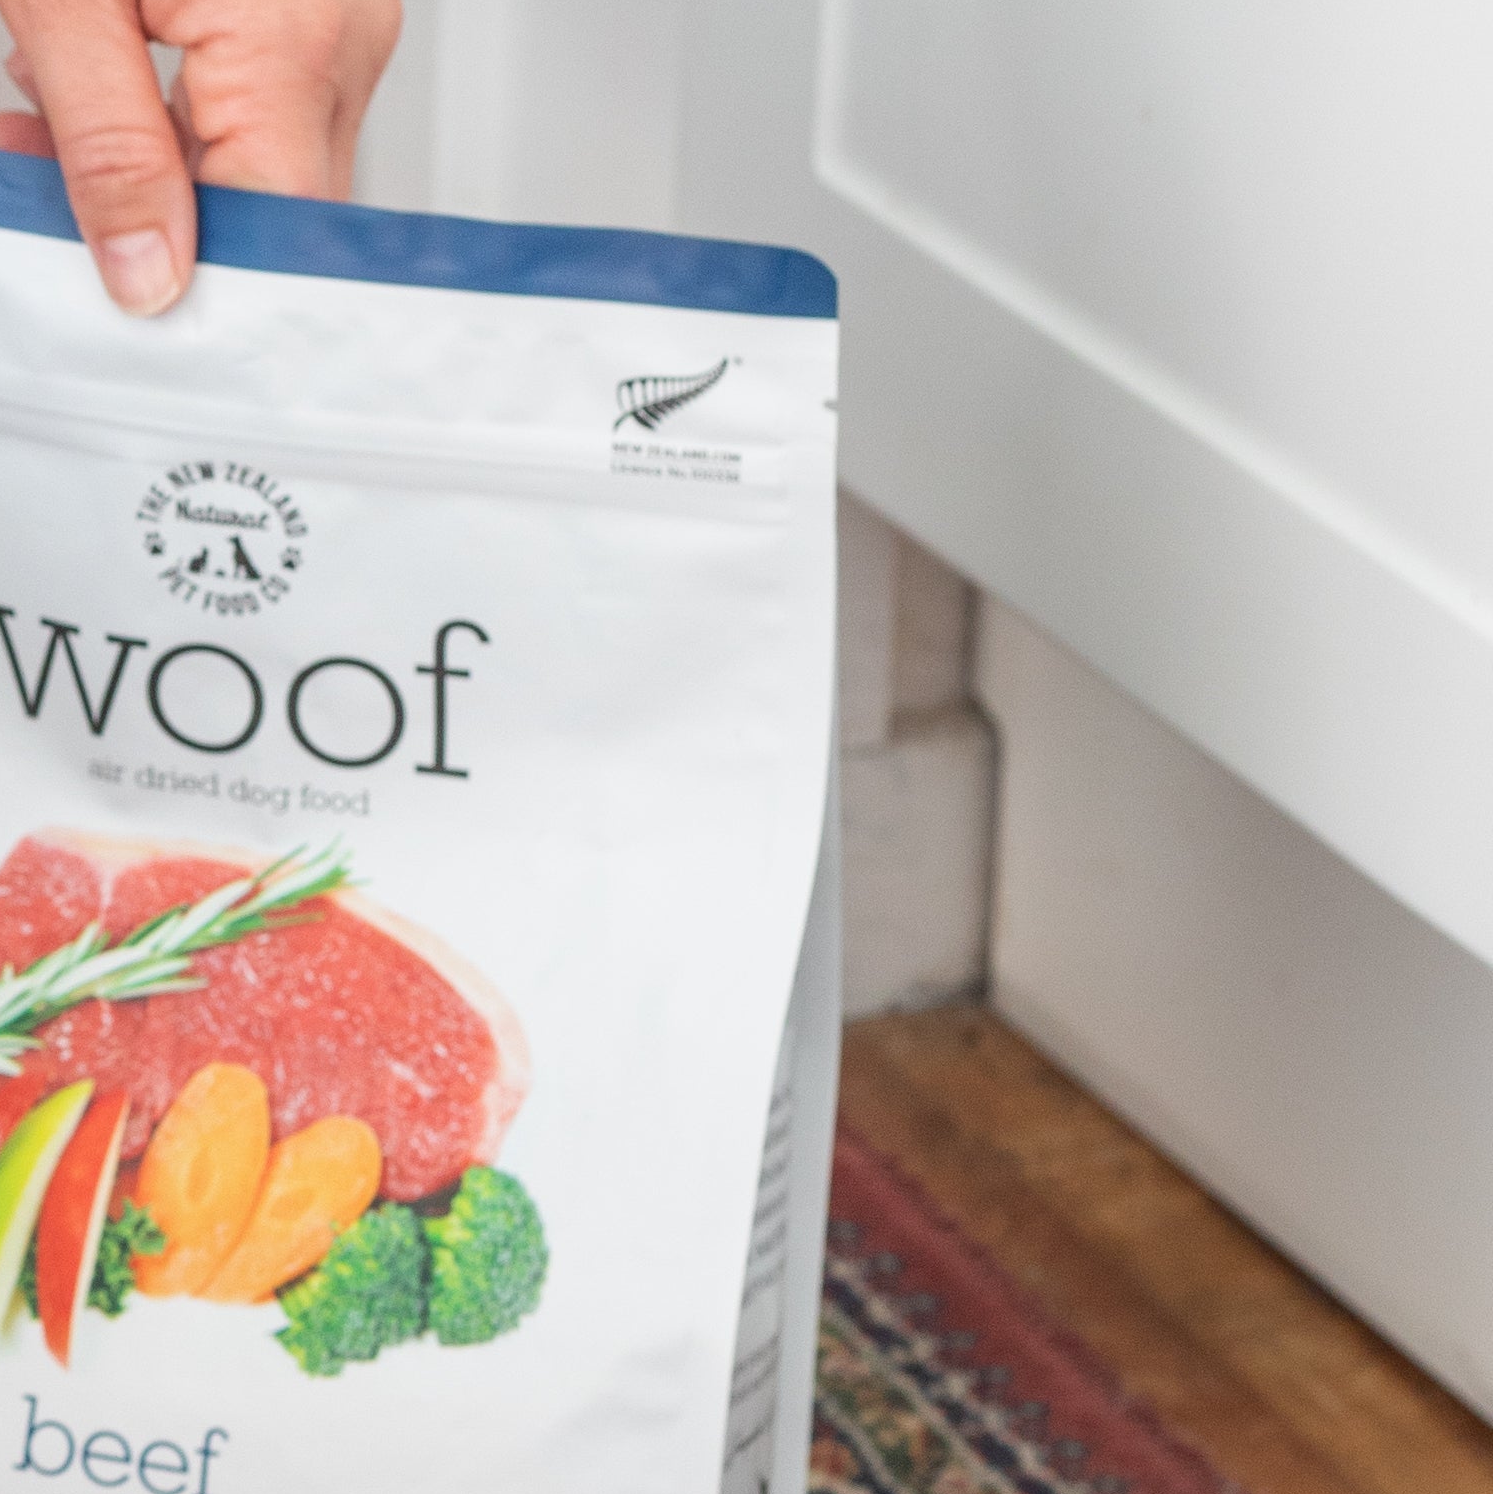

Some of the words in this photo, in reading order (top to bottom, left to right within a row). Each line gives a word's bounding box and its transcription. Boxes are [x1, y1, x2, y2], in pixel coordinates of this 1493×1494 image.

[137, 484, 172, 522] THE
[167, 462, 215, 487] NEW
[225, 462, 308, 538] ZEALAND
[175, 498, 270, 530] Natural
[159, 565, 198, 603] PET
[202, 590, 261, 616] FOOD
[261, 575, 290, 603] CO
[88, 757, 125, 785] air
[134, 762, 219, 798] dried
[228, 776, 291, 810] dog
[300, 784, 370, 816] food
